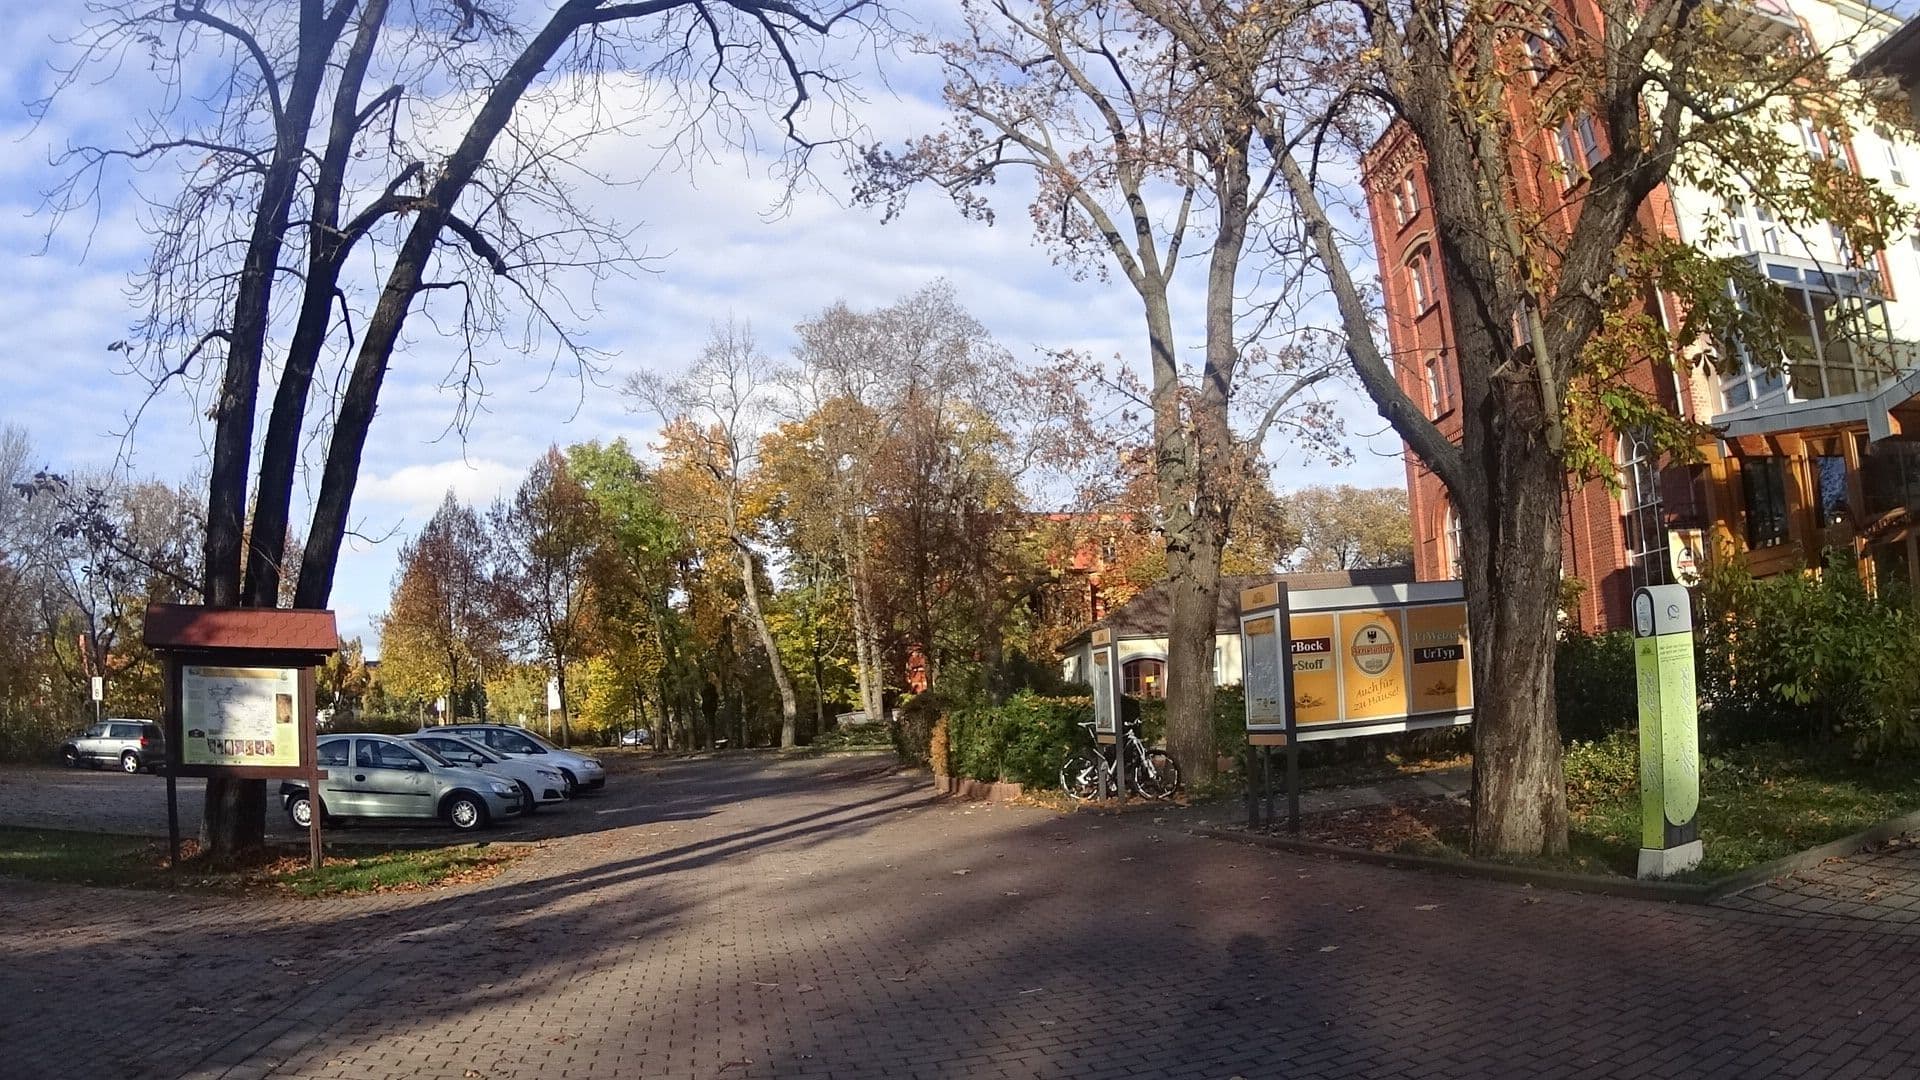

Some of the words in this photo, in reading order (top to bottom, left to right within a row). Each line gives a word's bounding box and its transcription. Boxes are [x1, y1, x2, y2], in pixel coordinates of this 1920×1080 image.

[1290, 639, 1323, 652] rBock
[1423, 647, 1455, 660] UrTyp
[1292, 659, 1324, 671] rStoff
[1355, 680, 1379, 699] Auch
[1378, 677, 1394, 696] für
